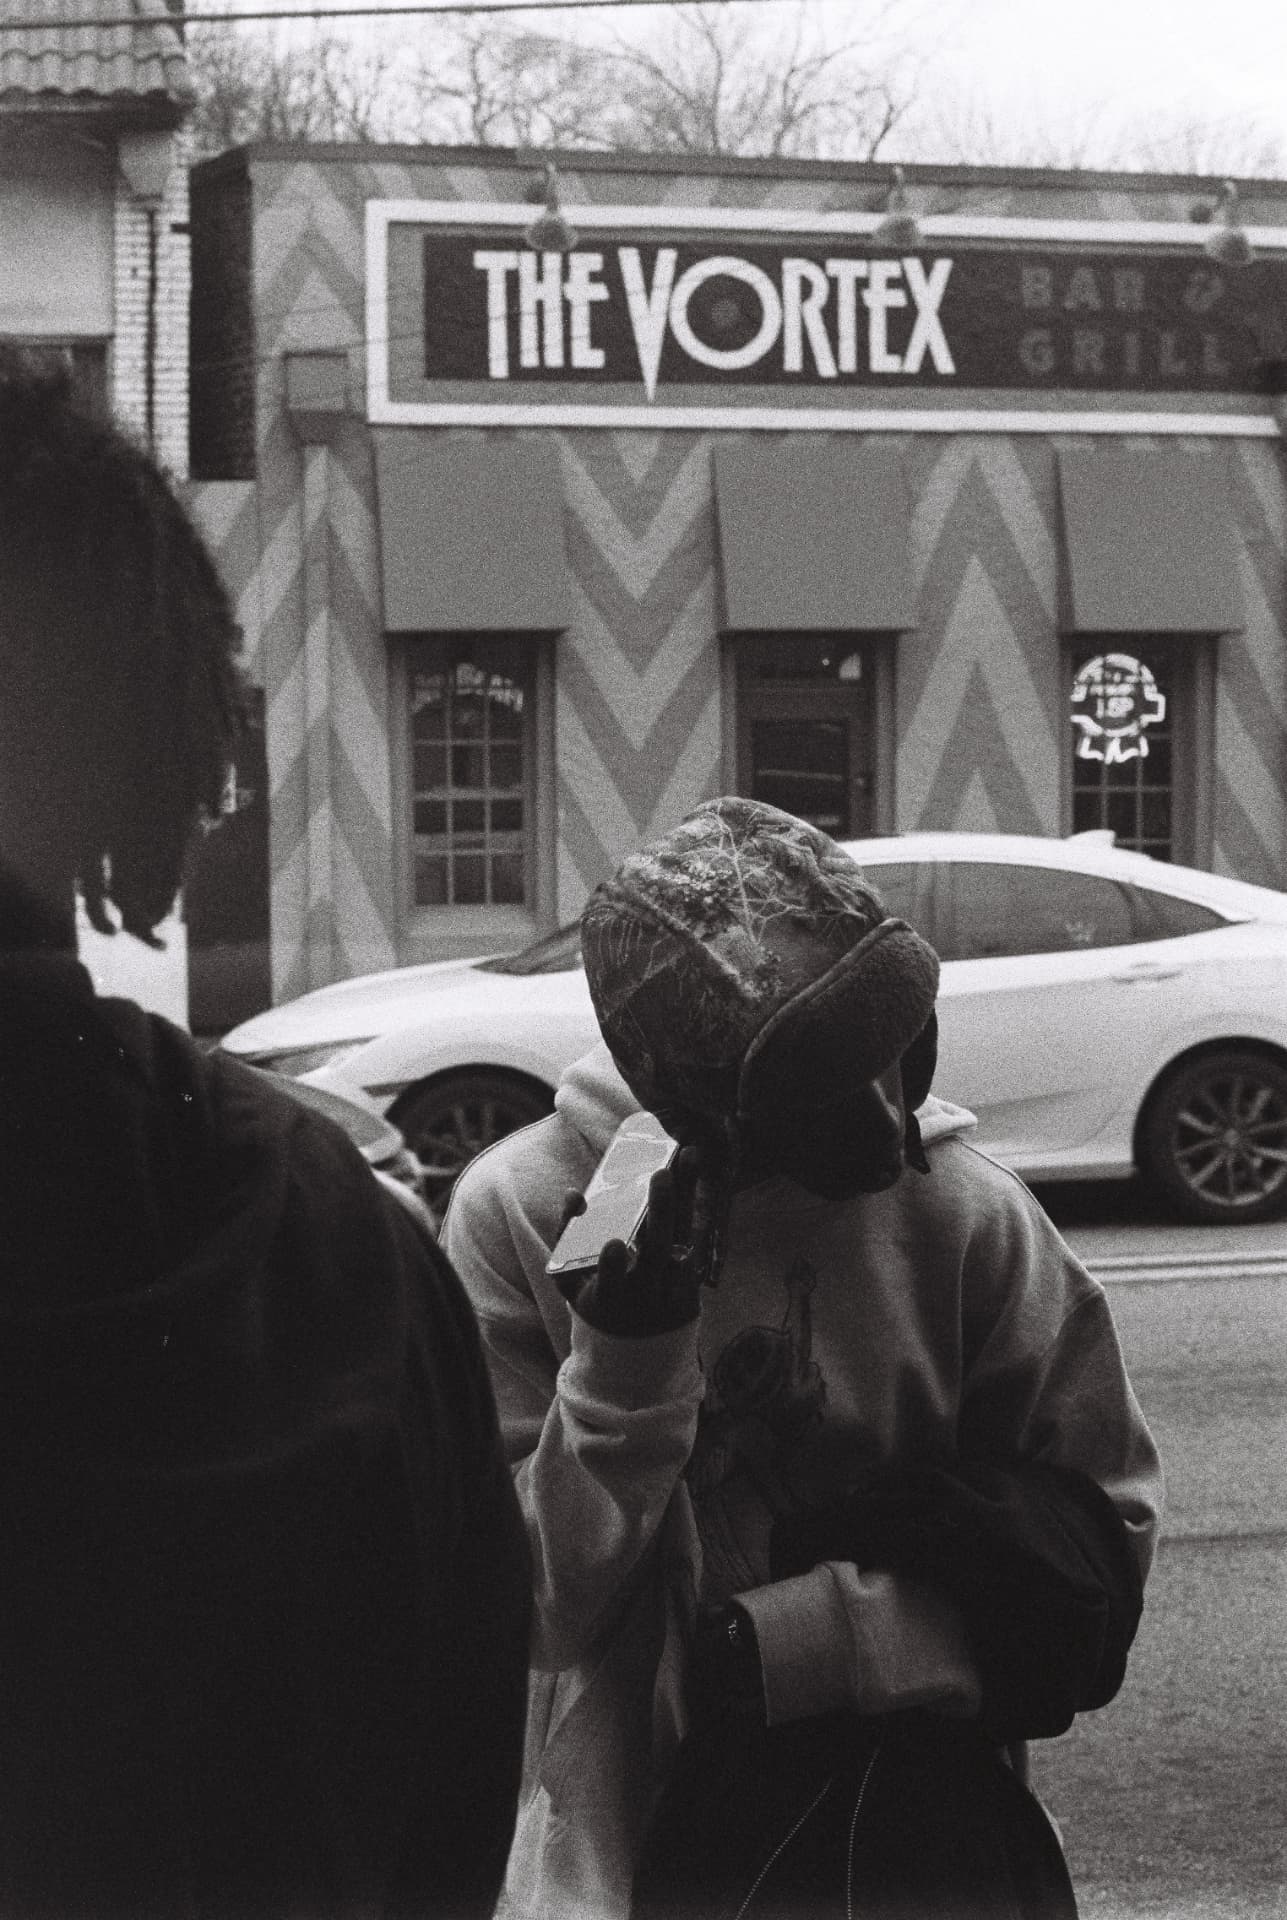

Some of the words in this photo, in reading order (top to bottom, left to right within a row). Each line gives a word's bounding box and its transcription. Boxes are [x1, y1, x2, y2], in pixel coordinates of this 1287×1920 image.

[1020, 266, 1146, 311] BAR
[473, 250, 610, 379] THE
[617, 247, 957, 401] VORTEX
[1018, 328, 1231, 376] GRILL
